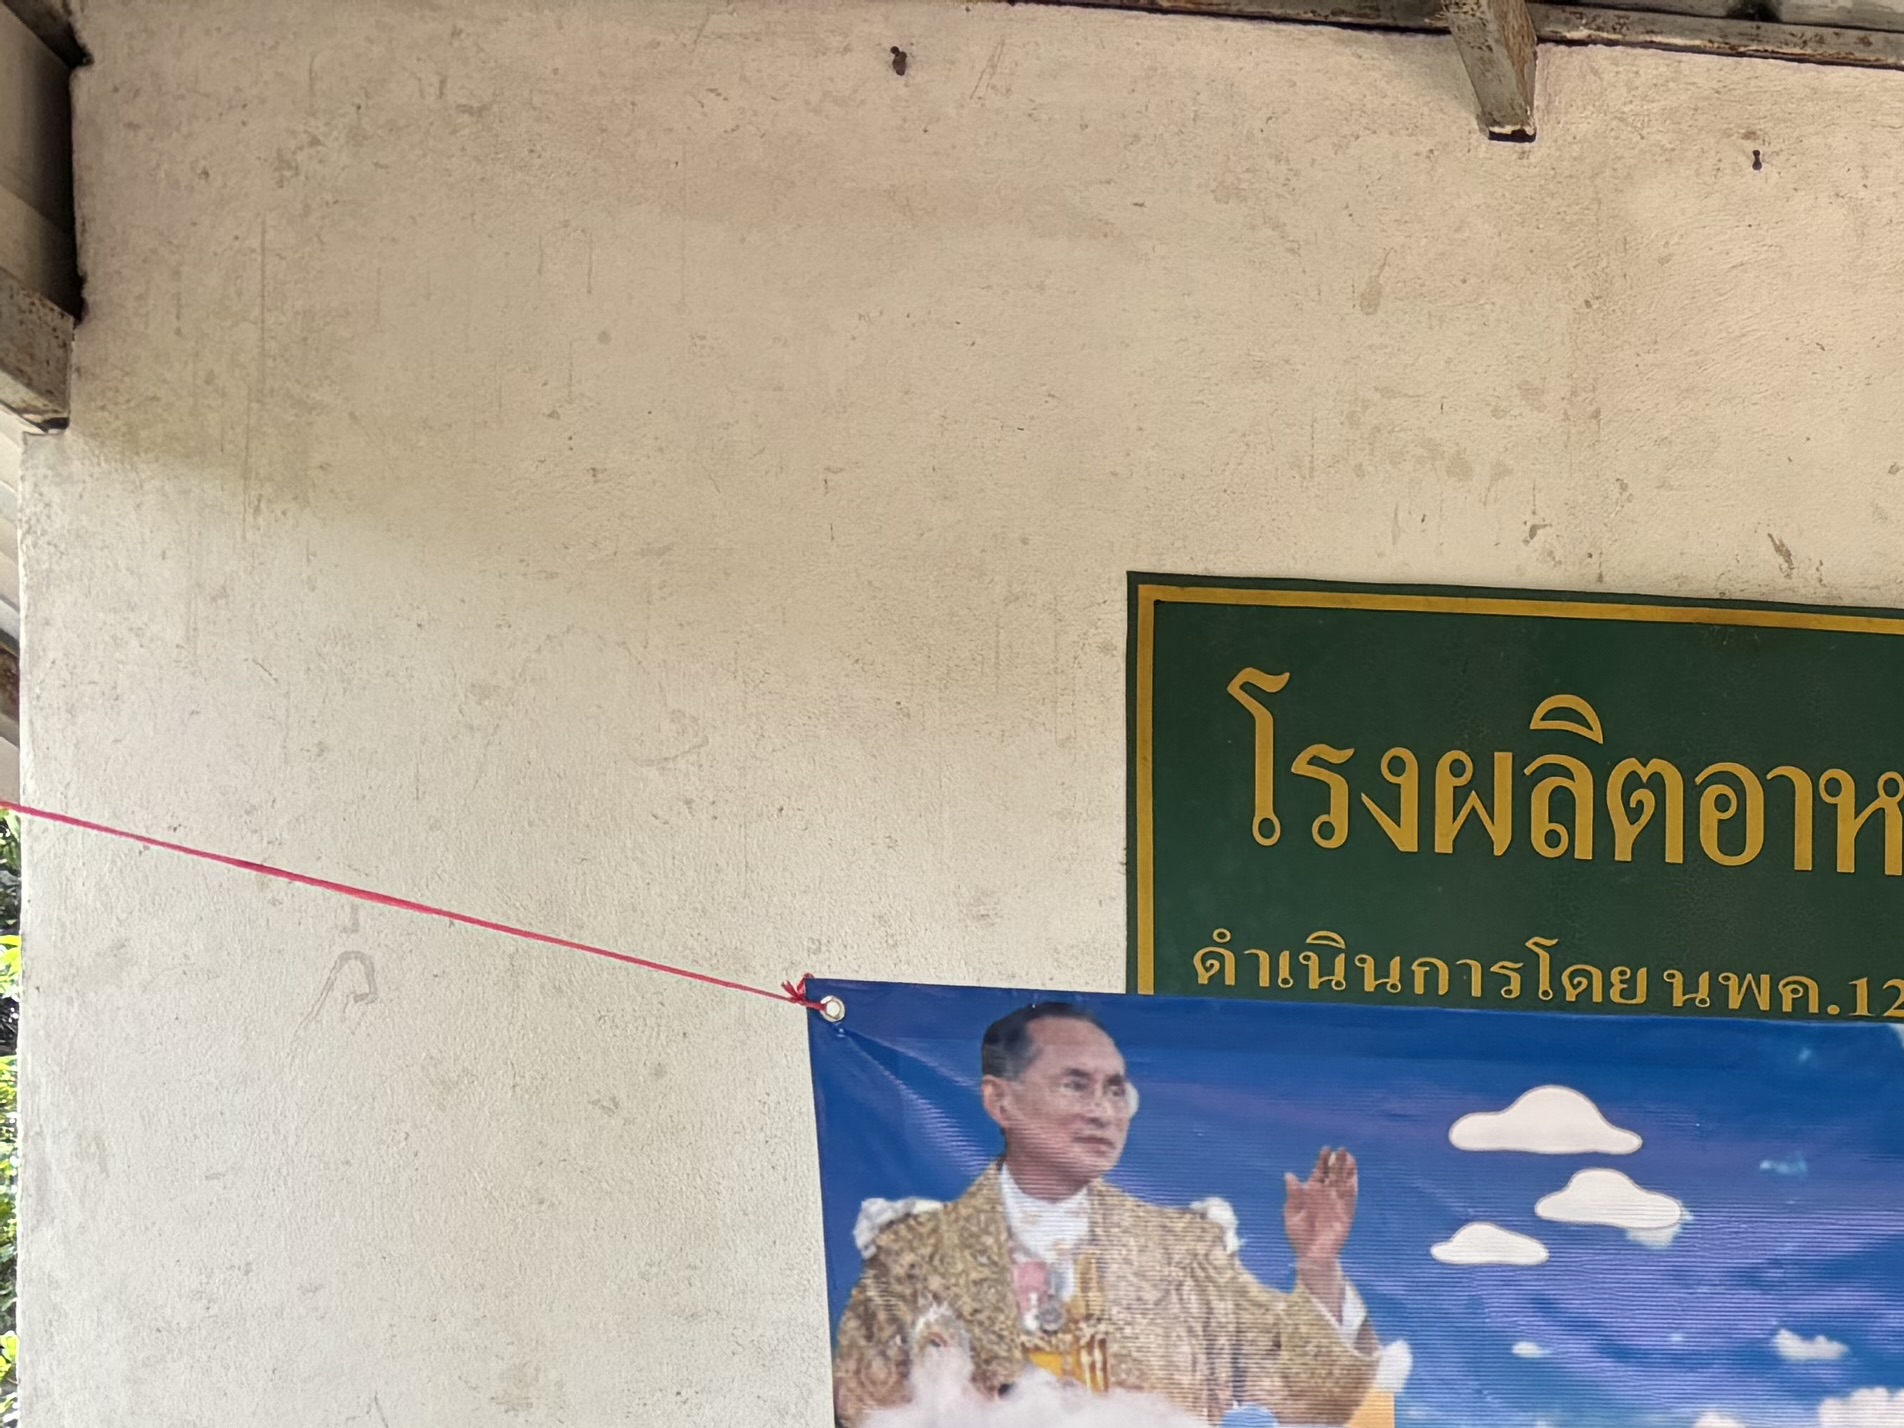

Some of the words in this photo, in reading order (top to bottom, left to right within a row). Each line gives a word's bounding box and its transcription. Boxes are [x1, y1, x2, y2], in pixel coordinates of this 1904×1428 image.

[1192, 928, 1648, 1005] ดำเนินการโดย
